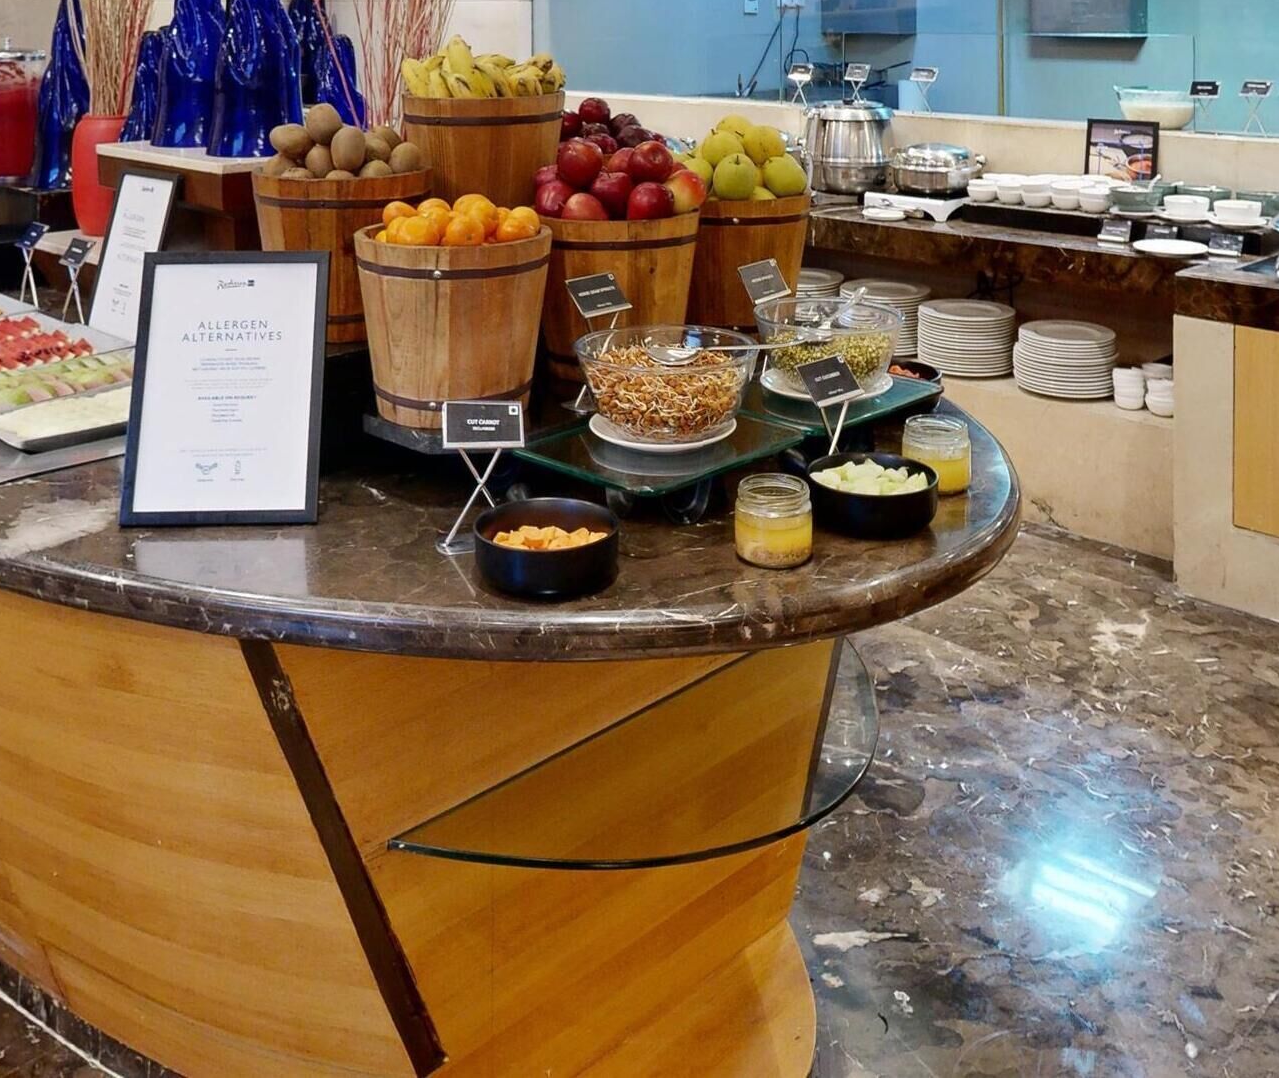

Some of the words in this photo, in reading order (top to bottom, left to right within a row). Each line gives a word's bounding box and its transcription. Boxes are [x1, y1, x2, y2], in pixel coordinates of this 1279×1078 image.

[198, 320, 268, 330] ALLERGEN
[182, 331, 282, 342] ALTERNATIVES
[466, 418, 478, 426] CUT
